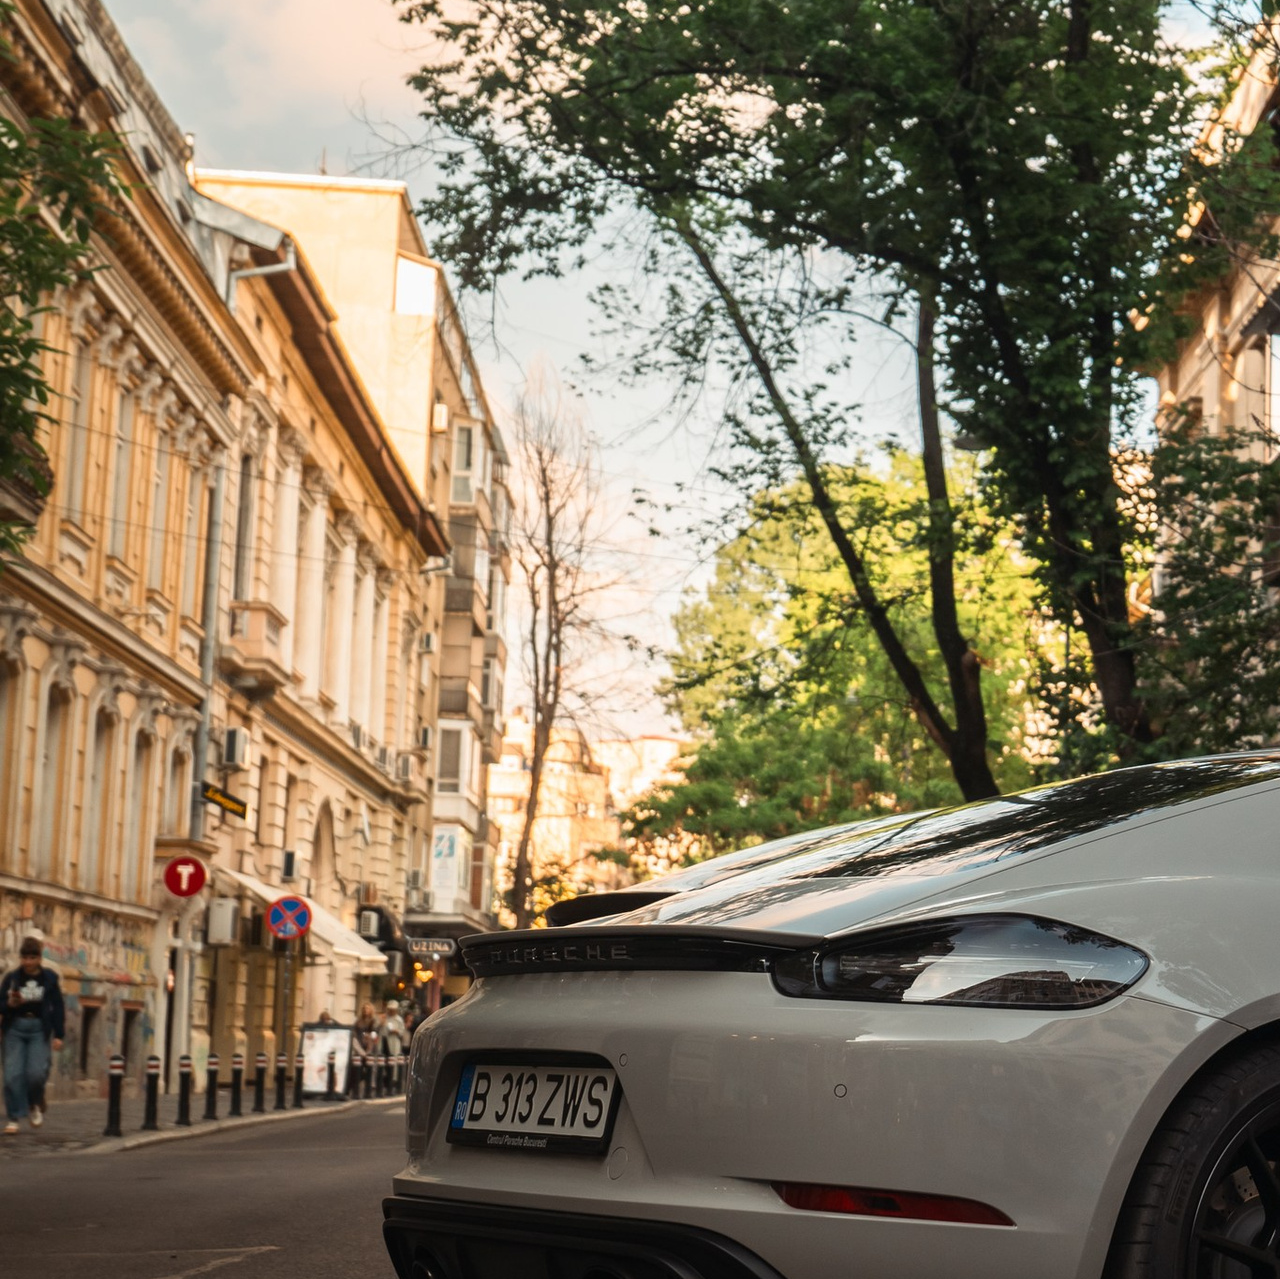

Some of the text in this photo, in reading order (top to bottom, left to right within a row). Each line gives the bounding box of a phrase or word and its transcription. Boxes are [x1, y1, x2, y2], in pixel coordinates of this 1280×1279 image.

[176, 863, 195, 891] T
[412, 941, 450, 951] UZINA
[455, 1101, 468, 1120] RO
[468, 1072, 608, 1128] B 313 ZWS
